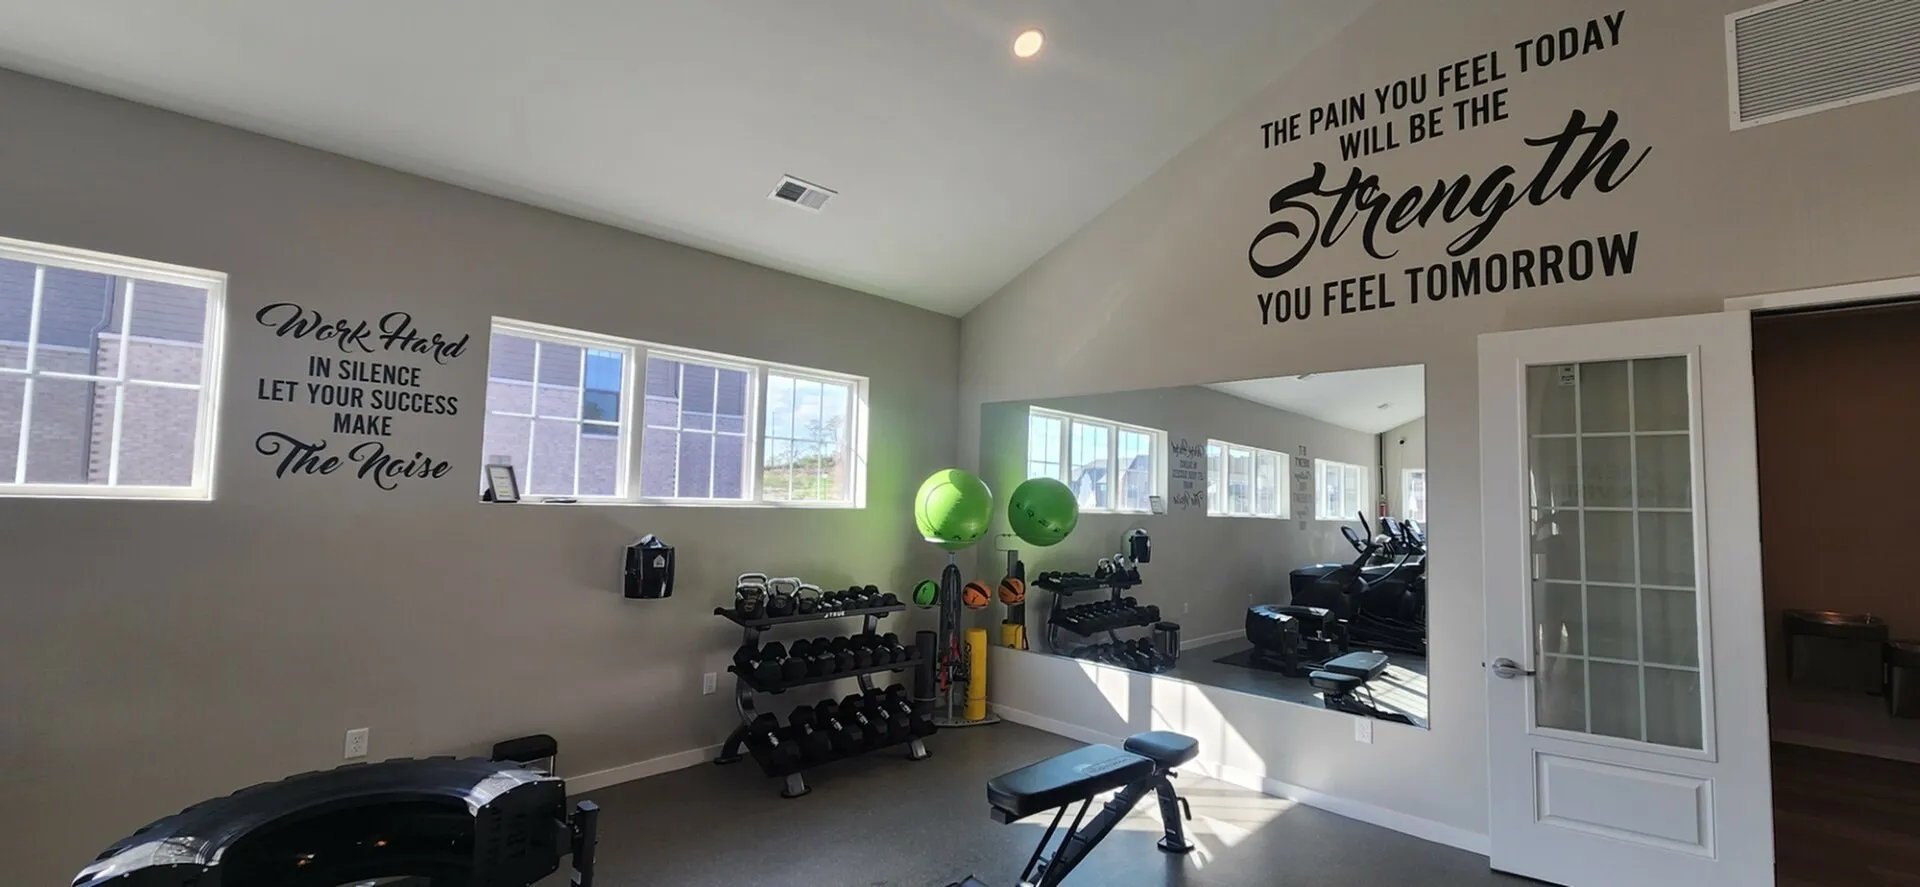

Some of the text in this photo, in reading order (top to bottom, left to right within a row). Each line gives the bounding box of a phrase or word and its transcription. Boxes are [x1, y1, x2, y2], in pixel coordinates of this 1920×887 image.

[1260, 9, 1627, 149] THE PAIN YOU FEEL TODAY
[1338, 87, 1510, 162] WILL BE THE
[1247, 108, 1653, 279] Strength
[1256, 230, 1639, 325] YOU FEEL TOMORROW
[255, 302, 470, 366] Work Hard
[257, 378, 459, 416] LET YOUR SUCCESS
[308, 355, 422, 388] IN SILENCE
[332, 412, 393, 437] MAKE
[255, 431, 454, 491] The Noise
